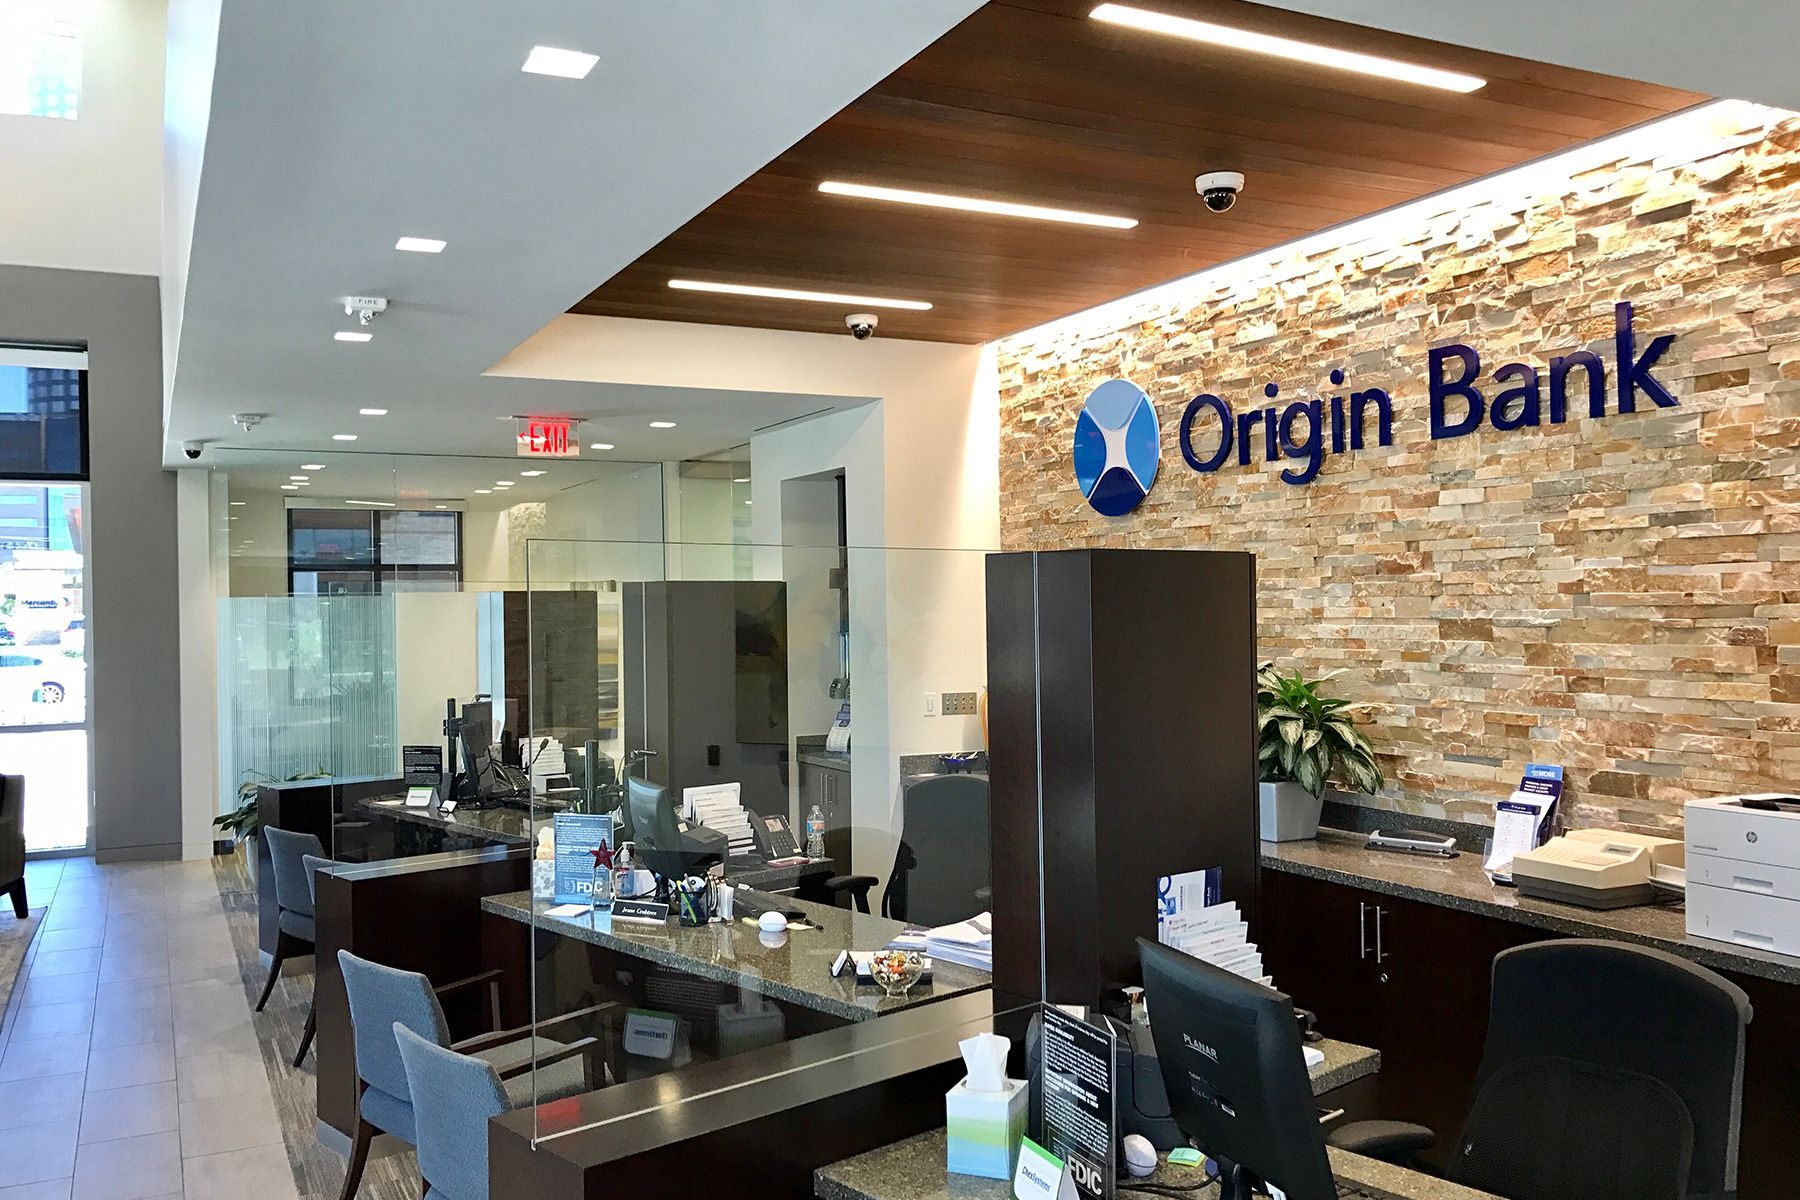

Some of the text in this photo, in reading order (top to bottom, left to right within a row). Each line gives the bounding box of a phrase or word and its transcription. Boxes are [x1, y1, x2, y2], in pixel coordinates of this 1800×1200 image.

[358, 298, 378, 306] FIRE
[1178, 300, 1682, 486] Origin Bank
[528, 421, 571, 453] EXIT
[1182, 1032, 1218, 1060] PLANAR
[1021, 1166, 1051, 1193] ChexSystems
[1067, 1154, 1103, 1196] FDIC
